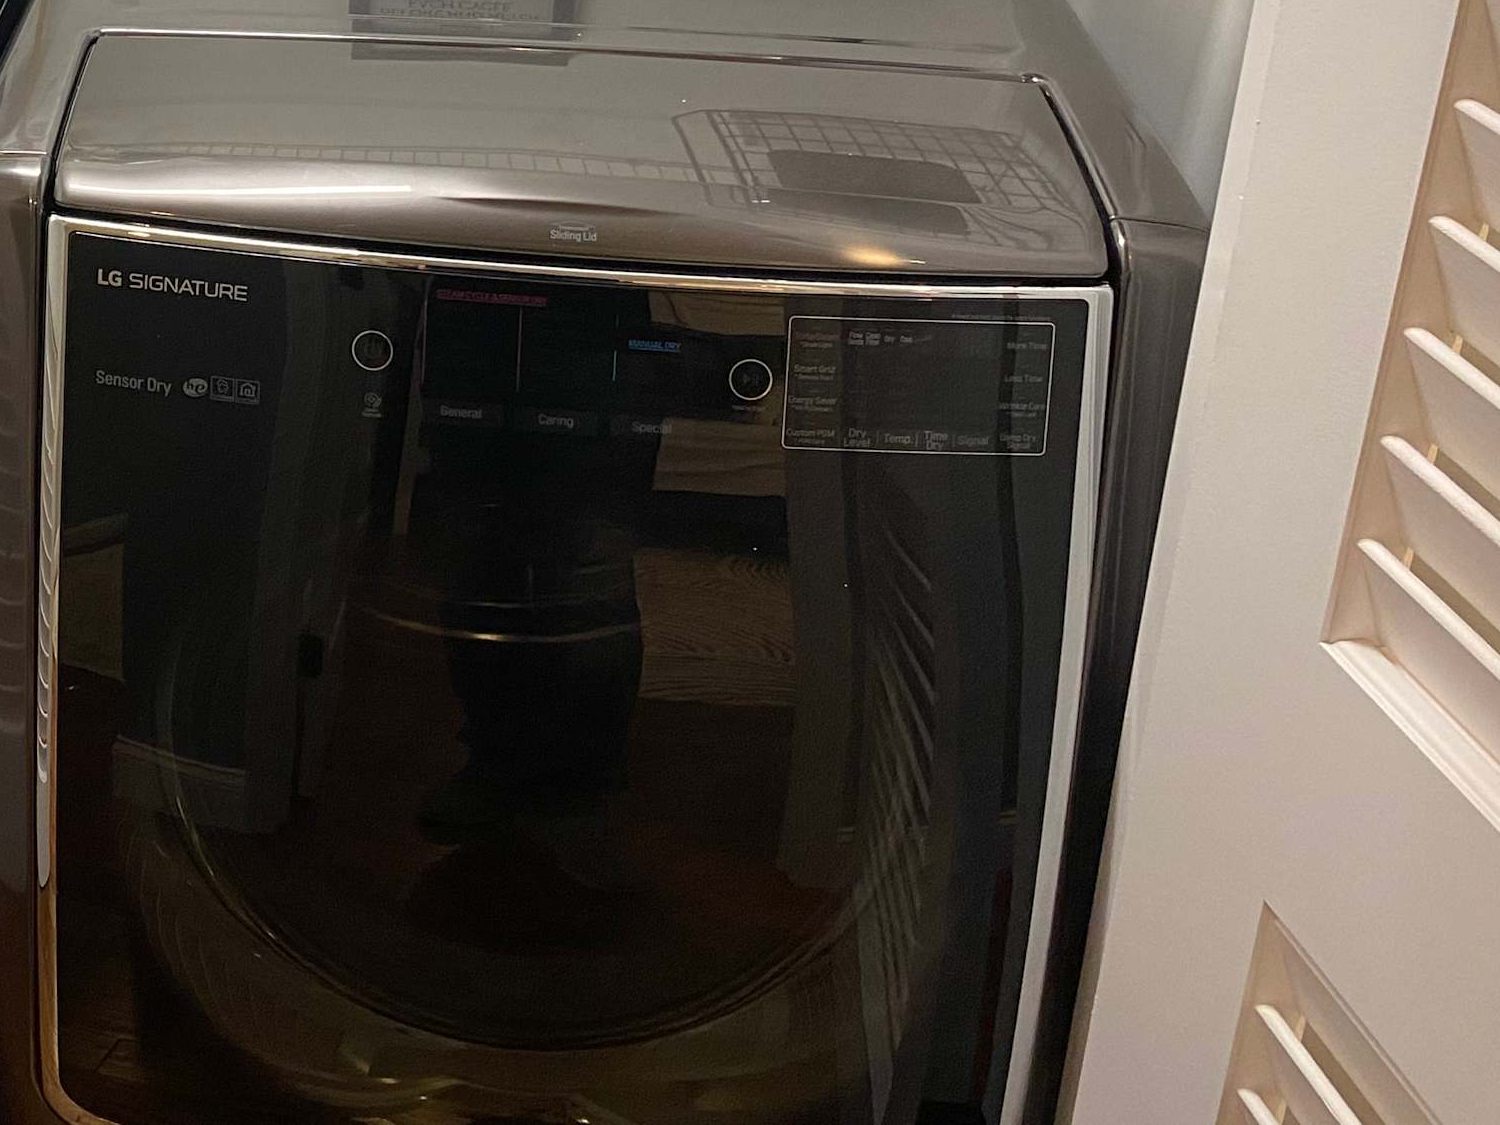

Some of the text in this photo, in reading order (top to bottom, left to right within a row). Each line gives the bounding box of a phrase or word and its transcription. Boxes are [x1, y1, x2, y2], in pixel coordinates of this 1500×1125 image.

[550, 229, 597, 242] Sliding Lid
[97, 268, 249, 302] LG SIGNATURE
[95, 370, 143, 390] Sensor
[147, 377, 172, 397] Dry
[538, 413, 574, 428] Caring
